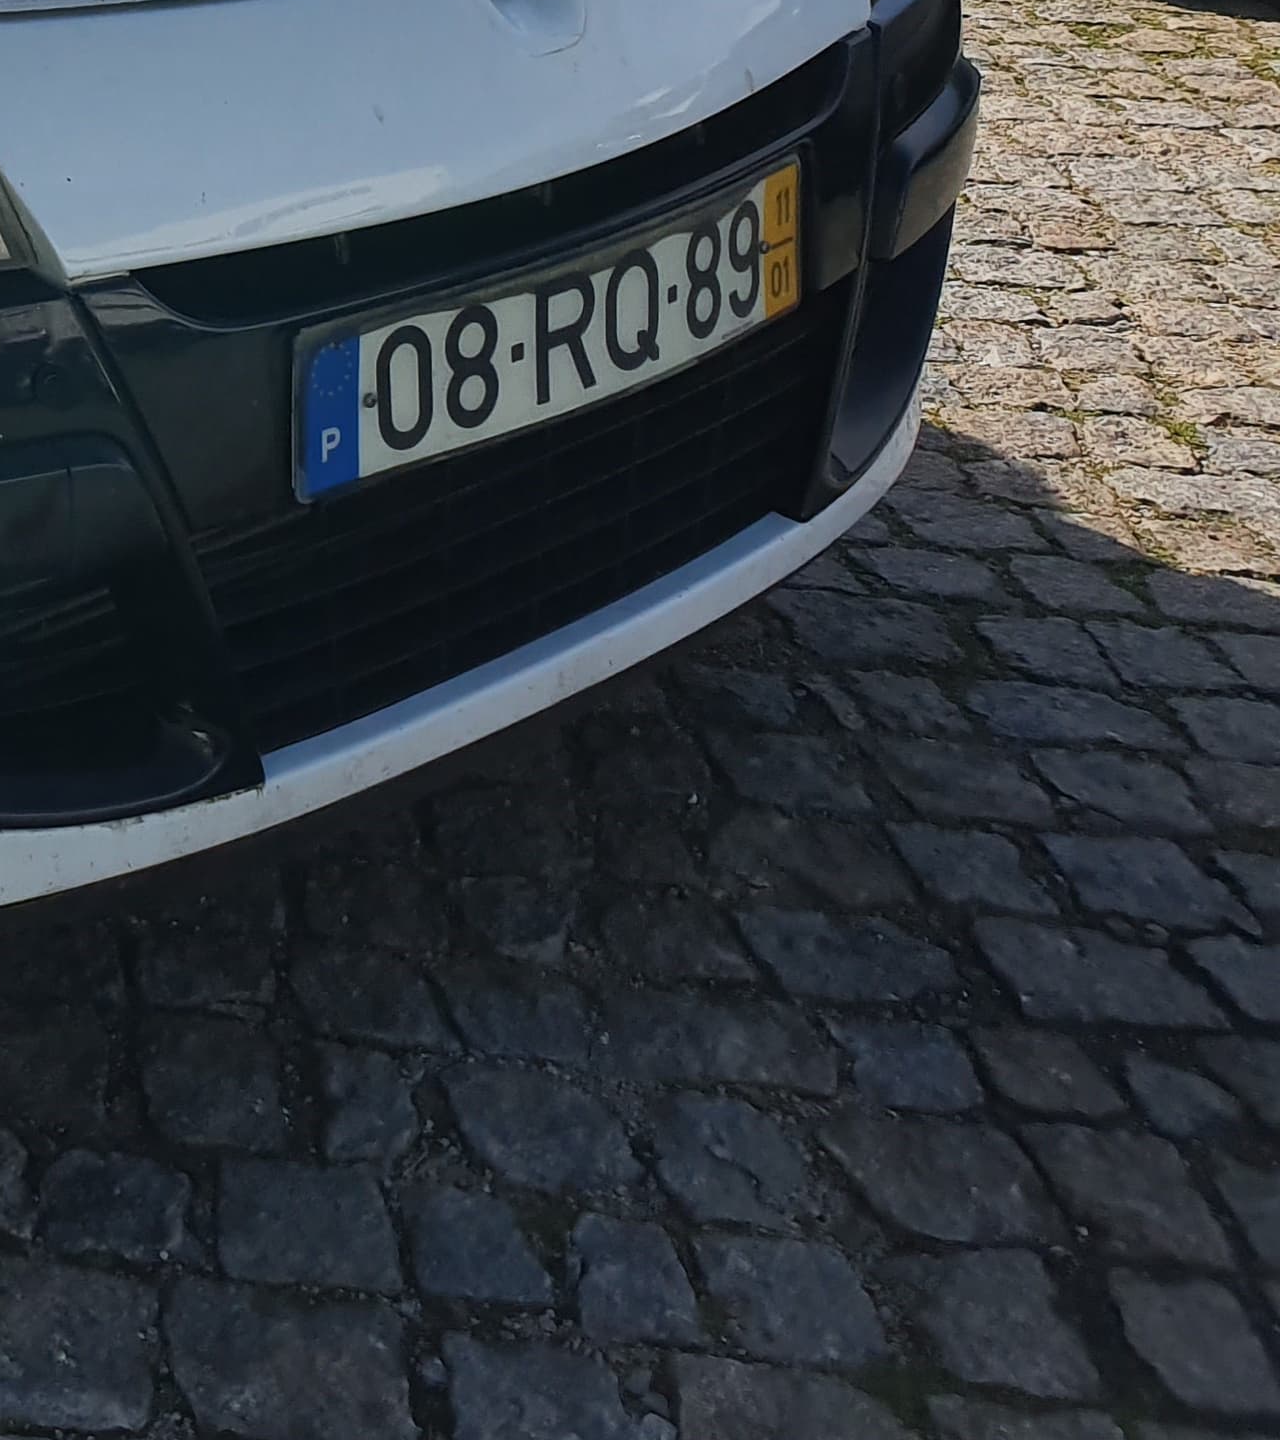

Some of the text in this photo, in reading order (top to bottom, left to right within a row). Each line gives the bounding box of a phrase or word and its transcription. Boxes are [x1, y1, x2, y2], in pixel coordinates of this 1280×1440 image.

[776, 185, 790, 227] 11
[771, 256, 790, 300] 01
[321, 426, 340, 464] P
